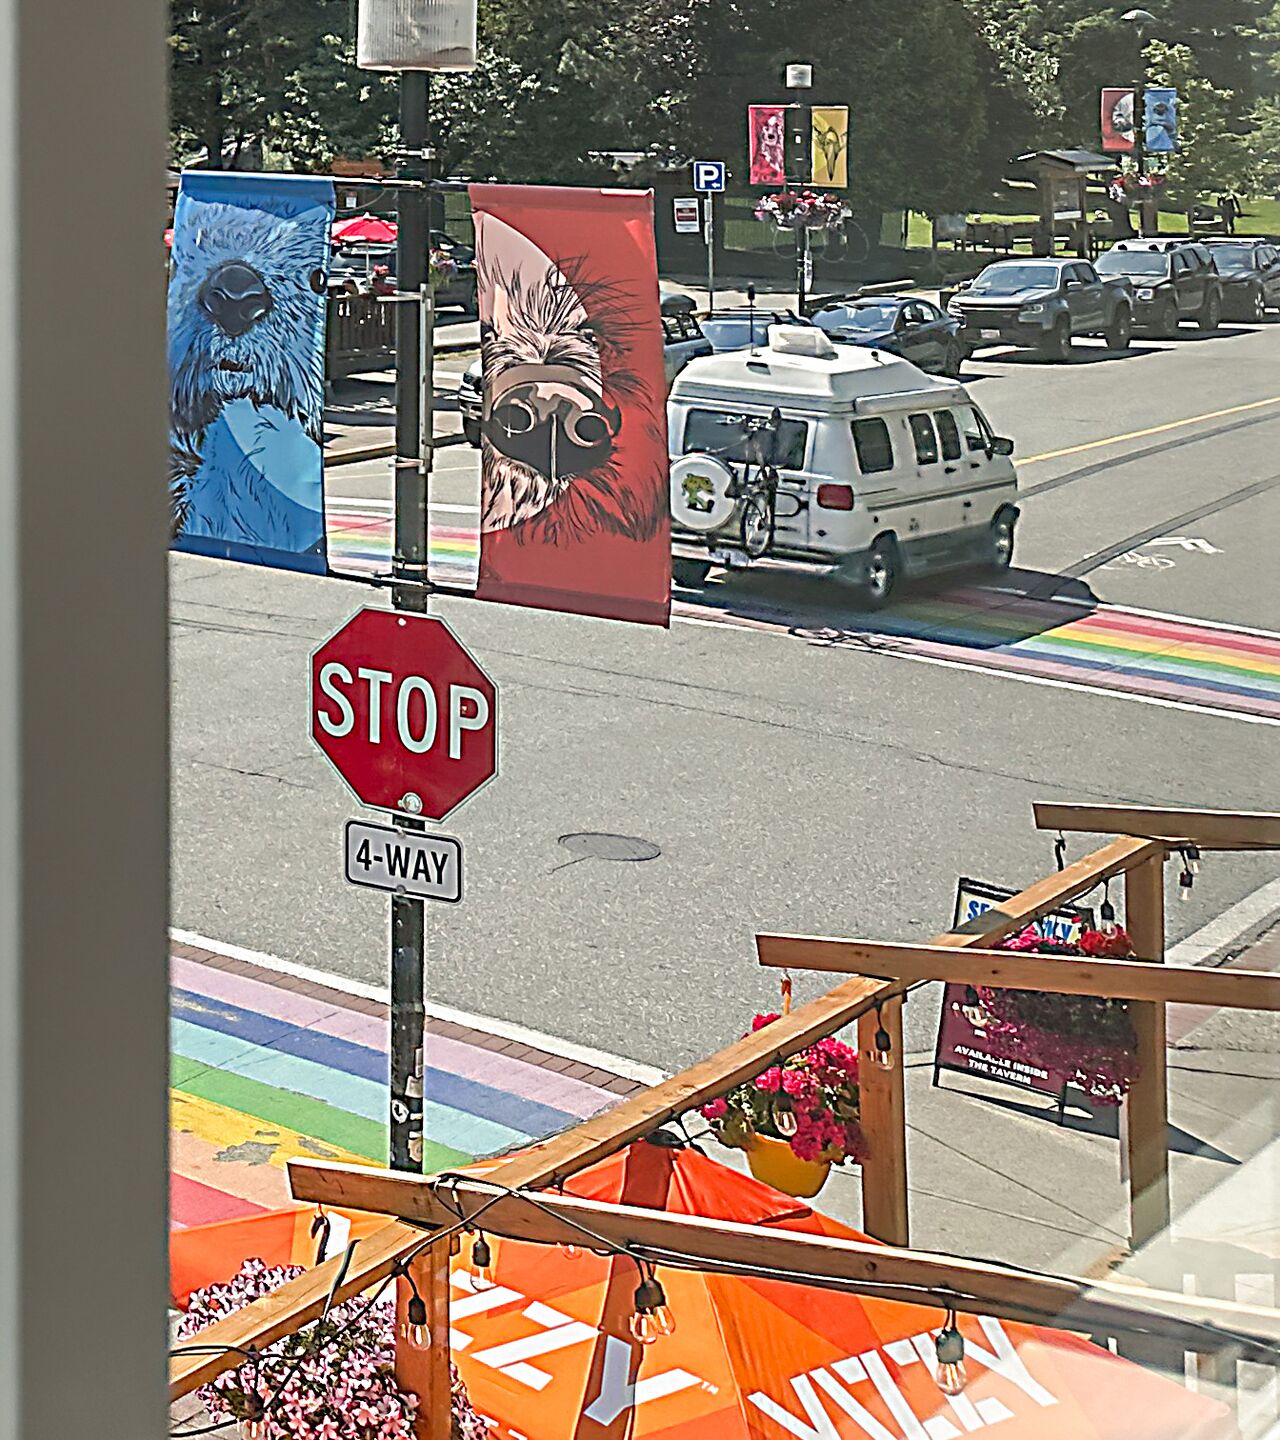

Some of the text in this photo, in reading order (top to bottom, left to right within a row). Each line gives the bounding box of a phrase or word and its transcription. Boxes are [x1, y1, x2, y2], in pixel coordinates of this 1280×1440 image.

[699, 165, 719, 188] P
[318, 662, 489, 760] STOP
[356, 838, 448, 885] 4-WAY
[968, 1059, 1031, 1085] THE TAVERN
[1013, 1062, 1049, 1080] INSIDE
[747, 1316, 1058, 1440] VIZZY
